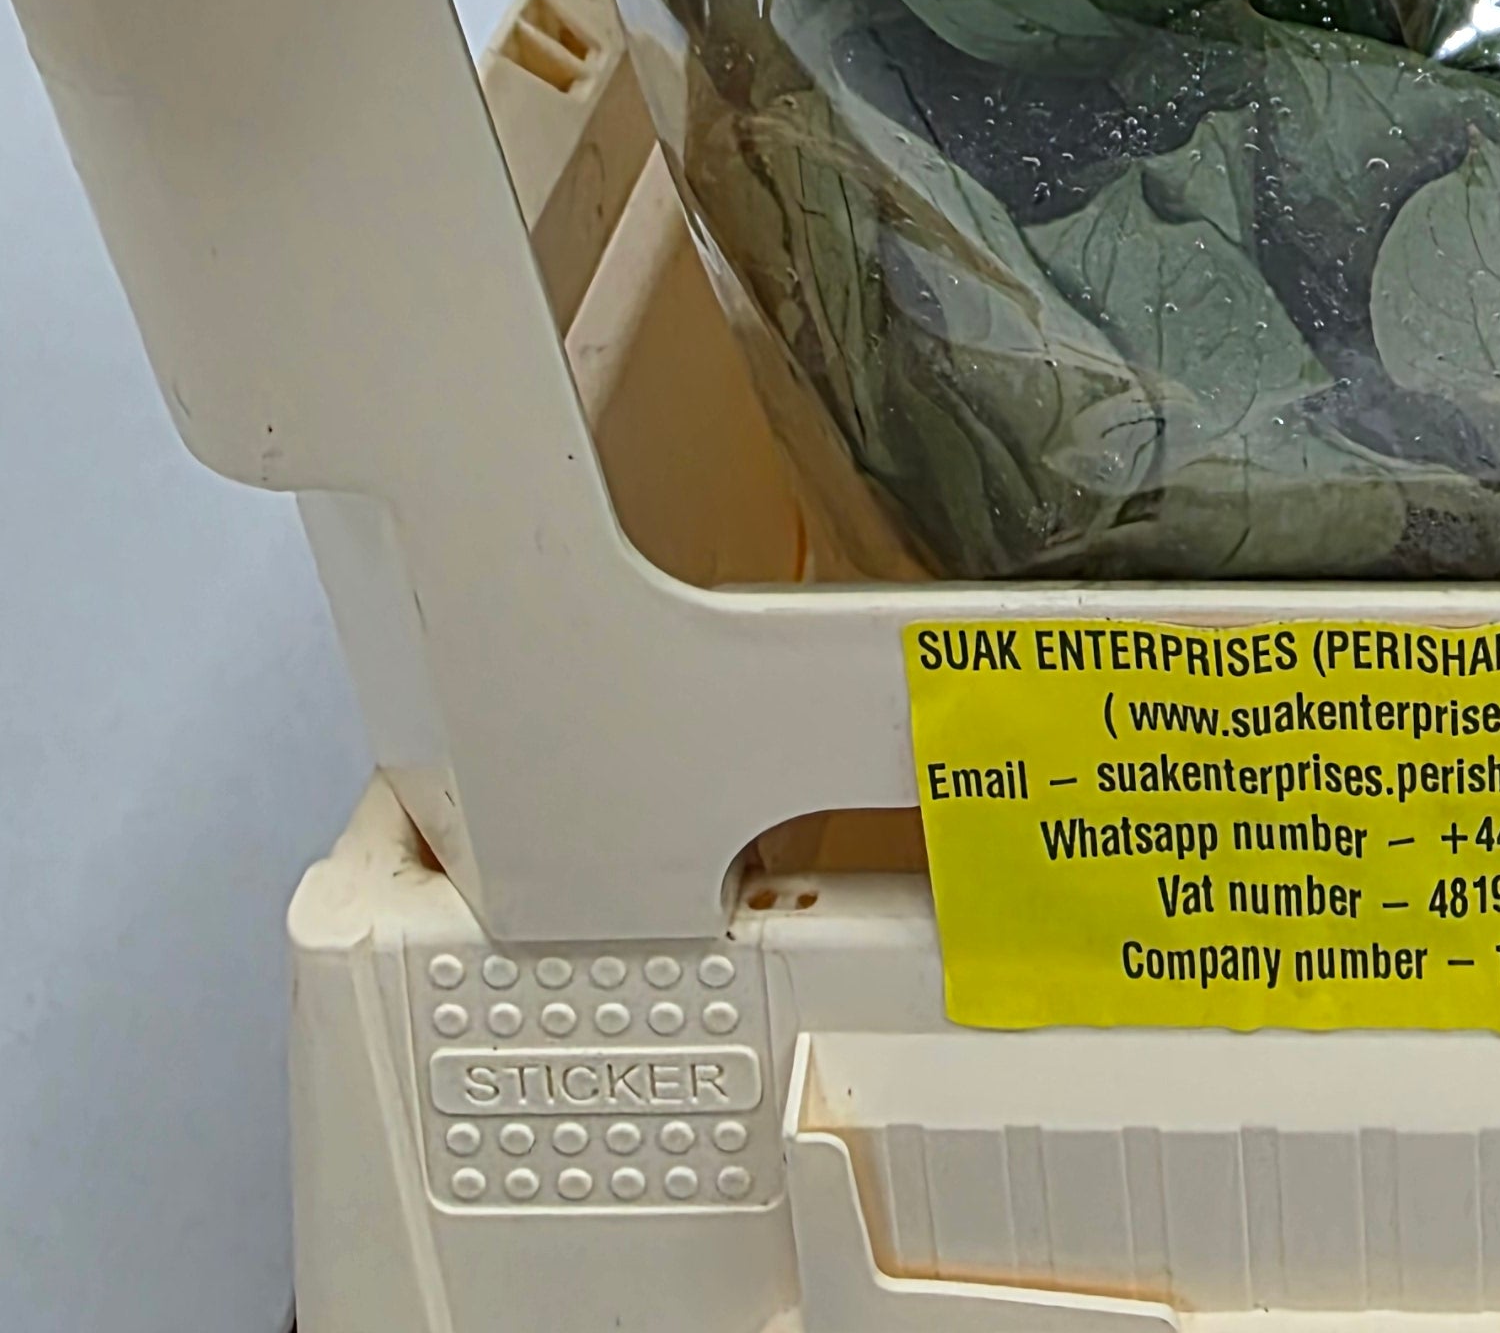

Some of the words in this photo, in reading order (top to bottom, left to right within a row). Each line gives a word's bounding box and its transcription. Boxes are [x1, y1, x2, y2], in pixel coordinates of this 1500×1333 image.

[918, 630, 1021, 670] SUAK
[1036, 630, 1297, 677] ENTERPRISES
[928, 761, 1028, 800] Email
[1040, 817, 1217, 860] Whatsapp
[1234, 814, 1367, 858] number
[1158, 875, 1214, 917] Vat
[1229, 875, 1361, 918] number
[1123, 941, 1280, 989] Company
[1296, 943, 1427, 982] number
[464, 1063, 731, 1107] STICKER
